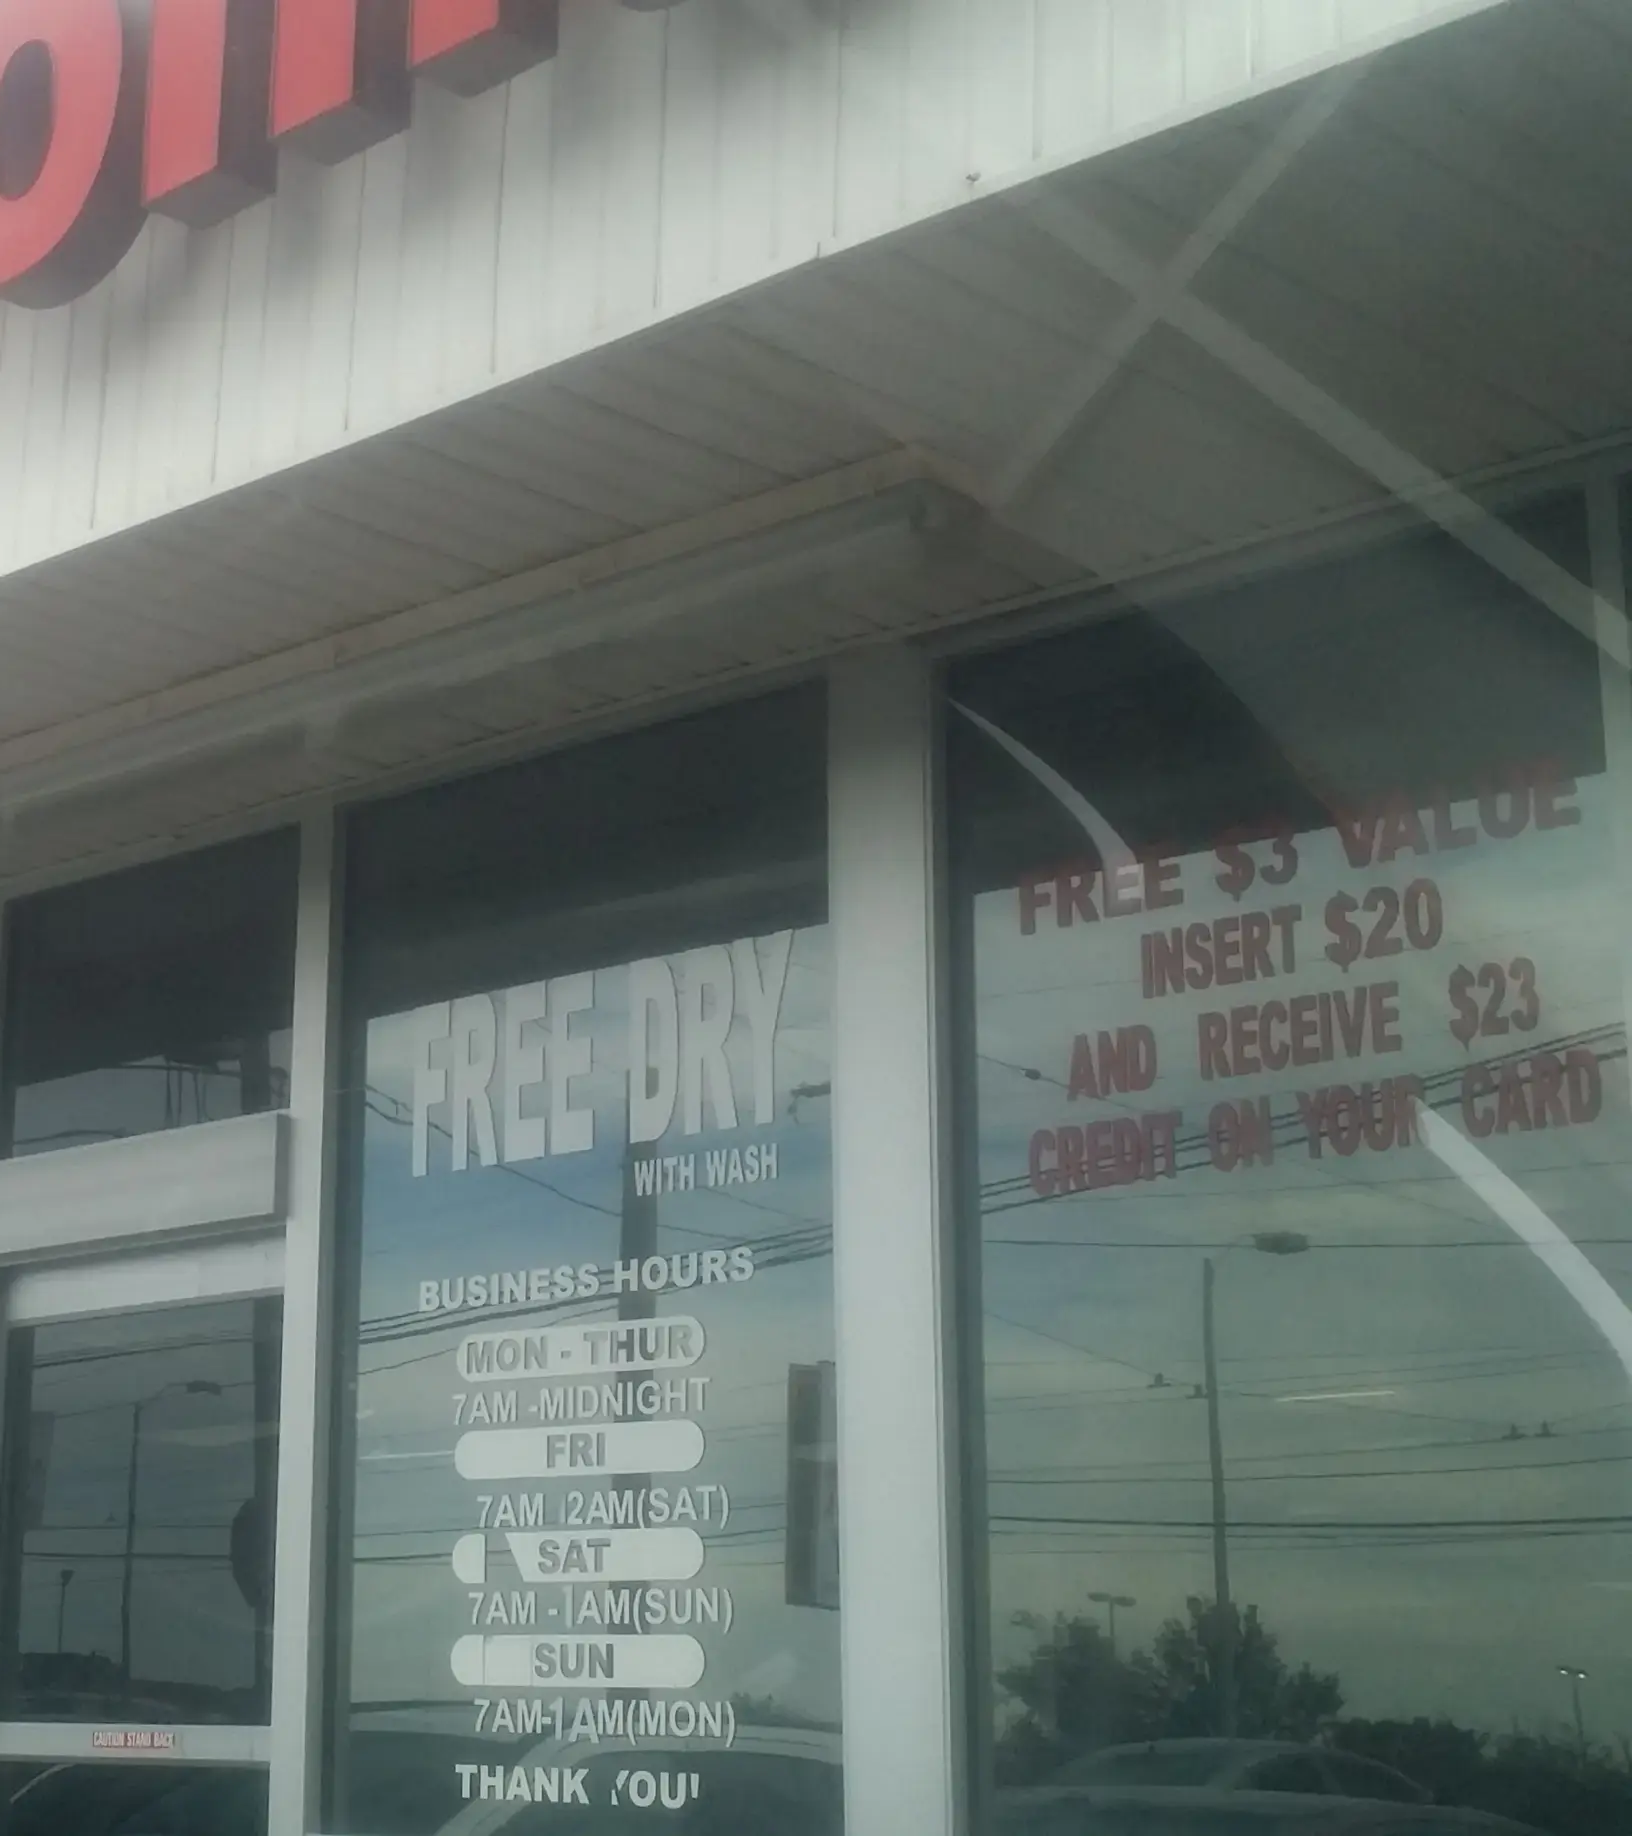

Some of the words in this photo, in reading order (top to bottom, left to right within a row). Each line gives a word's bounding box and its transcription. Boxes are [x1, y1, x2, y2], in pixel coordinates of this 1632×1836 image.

[1018, 840, 1184, 936] FREE
[1214, 816, 1299, 903] $3
[1328, 755, 1582, 870] VALUE
[1141, 904, 1303, 999] INSERT
[1324, 878, 1443, 973] $20
[411, 970, 595, 1178] FREE
[626, 928, 795, 1145] DRY
[1068, 1024, 1158, 1102] AND
[1197, 980, 1404, 1081] RECEIVE
[1448, 955, 1540, 1049] $23
[1027, 1109, 1183, 1198] CREDIT
[1207, 1101, 1275, 1173] ON
[1294, 1072, 1426, 1160] YOUR
[1460, 1049, 1604, 1139] CARD
[633, 1152, 696, 1197] WITH
[705, 1143, 780, 1189] WASH
[418, 1261, 602, 1313] BUSINESS
[613, 1245, 756, 1294] HOURS
[465, 1335, 549, 1375] MON
[582, 1323, 695, 1366] THUR
[451, 1389, 518, 1427] 7AM
[545, 1431, 607, 1470] FRI
[476, 1492, 545, 1529] 7AM
[536, 1537, 612, 1575] SAT
[468, 1590, 537, 1626] 7AM
[533, 1642, 615, 1680] SUN
[454, 1763, 590, 1805] THANK
